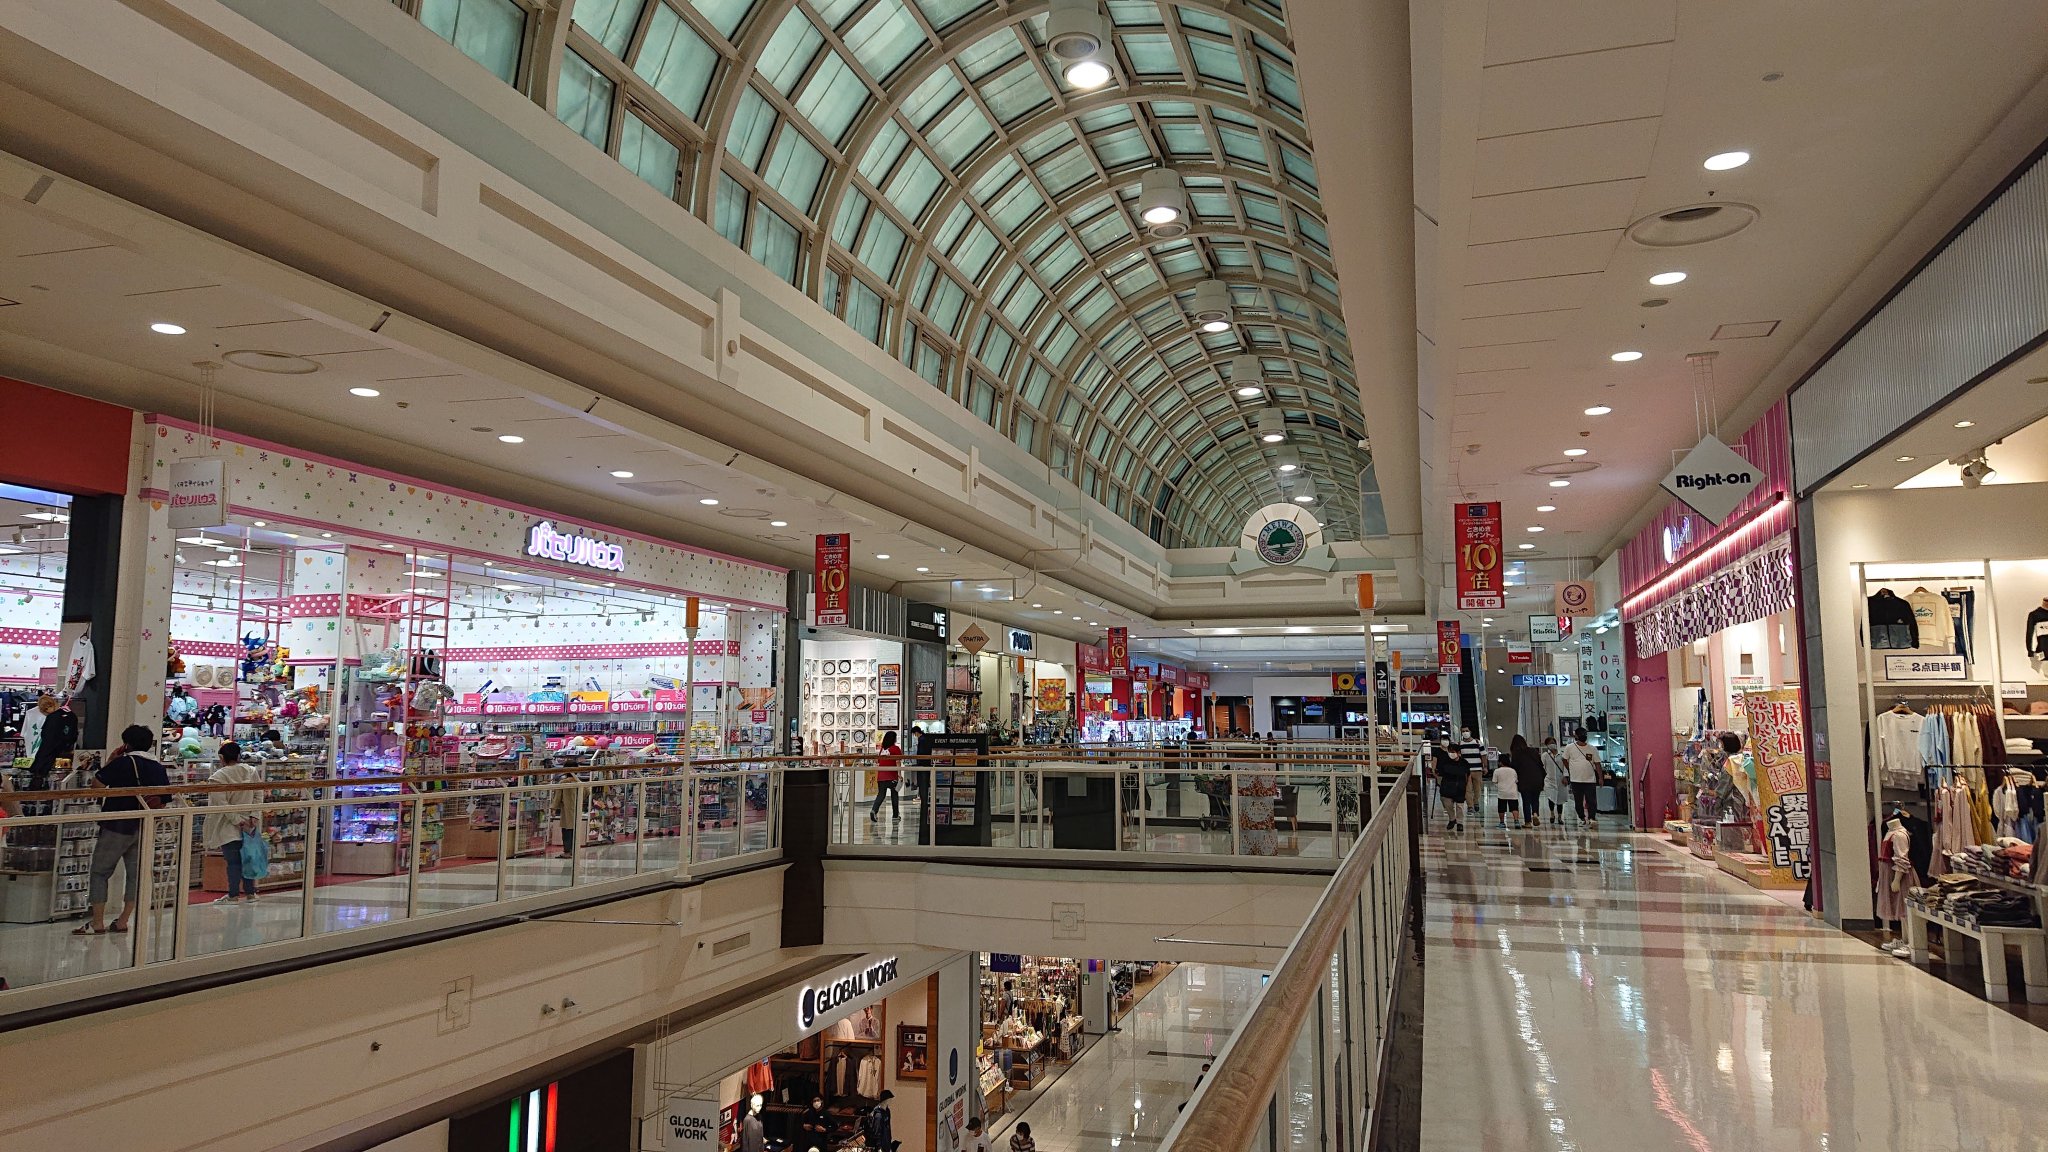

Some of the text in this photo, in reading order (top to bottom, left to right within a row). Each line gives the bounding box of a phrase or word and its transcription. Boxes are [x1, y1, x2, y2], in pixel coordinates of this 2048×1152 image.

[1676, 472, 1751, 490] Right-on
[170, 493, 217, 508] パセリハウス
[1263, 521, 1294, 534] MEIWA
[528, 521, 624, 572] パセリハウス
[1462, 543, 1497, 571] 10
[819, 568, 845, 593] 10
[1470, 572, 1490, 590] 倍
[825, 593, 839, 609] 倍
[1466, 598, 1496, 608] 開催中
[822, 615, 843, 624] 開催中
[1441, 641, 1458, 655] 10
[1581, 632, 1596, 714] 腕時計電池交
[1911, 662, 1962, 672] 2点目半額
[453, 705, 477, 713] 10%OFF
[495, 704, 519, 713] 10%OFF
[537, 704, 561, 712] 10%OFF
[577, 703, 603, 711] 10%OFF
[620, 702, 645, 711] 10%OFF
[1749, 696, 1776, 766] 売り尽くし
[1771, 701, 1803, 755] 振袖
[624, 736, 651, 745] 10%OFF
[1769, 806, 1790, 866] SALE
[817, 959, 898, 1014] GLOBAL WORK
[669, 1115, 714, 1130] GLOBAL
[674, 1128, 708, 1141] WORK
